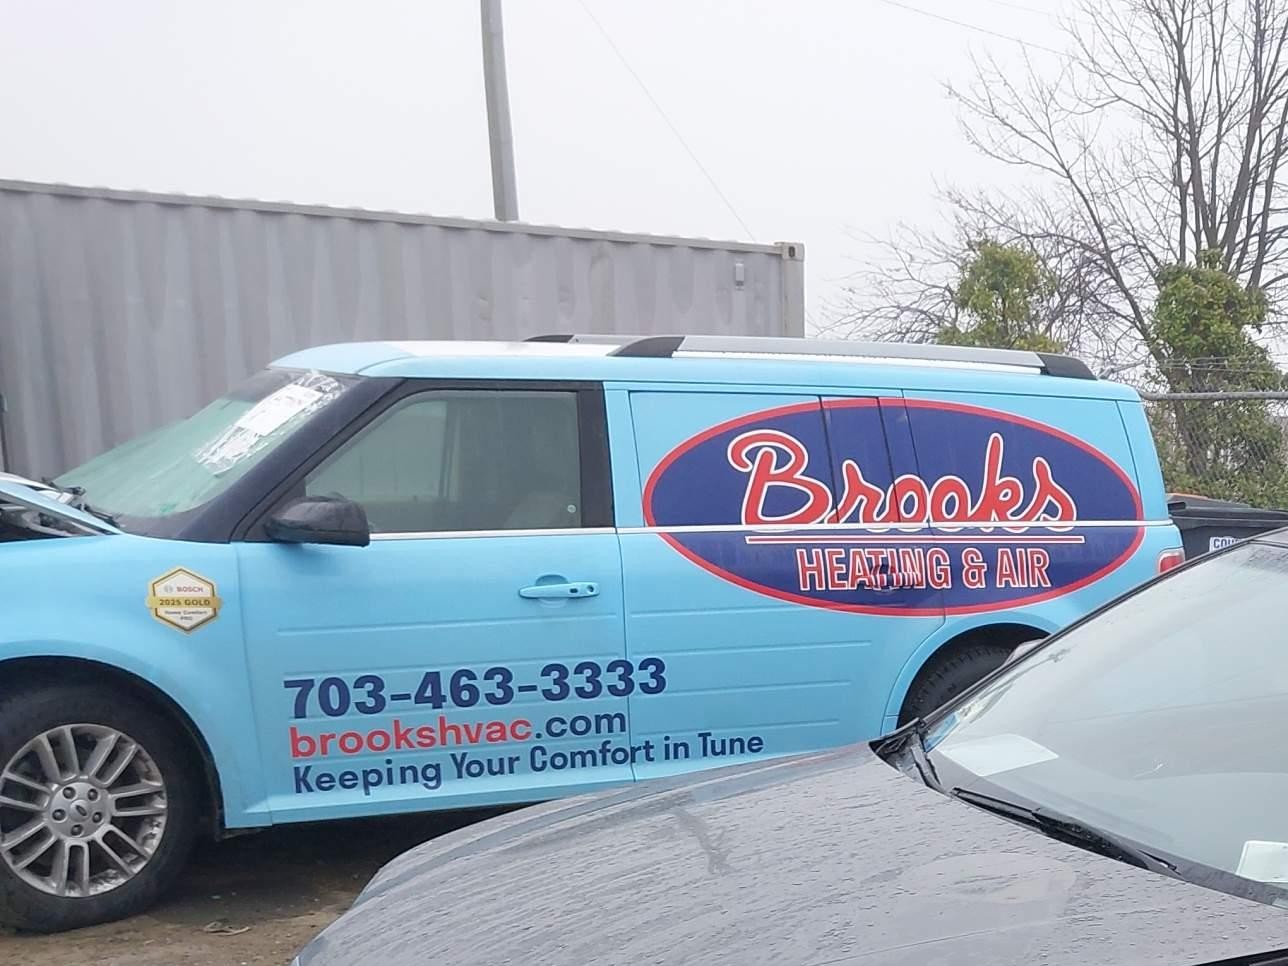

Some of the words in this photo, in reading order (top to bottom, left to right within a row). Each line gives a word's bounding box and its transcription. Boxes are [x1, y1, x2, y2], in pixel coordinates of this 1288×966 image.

[727, 429, 1078, 534] Brooks
[176, 585, 204, 593] BOSCH
[796, 547, 951, 592] HEATING
[962, 549, 988, 588] &
[996, 546, 1052, 589] AIR
[283, 656, 667, 720] 703-463-3333
[290, 710, 627, 759] brookshvac.com
[293, 757, 442, 797] Keeping
[450, 751, 520, 781] Your
[530, 738, 655, 772] Comfort
[663, 736, 690, 760] in
[697, 730, 764, 757] Tune
